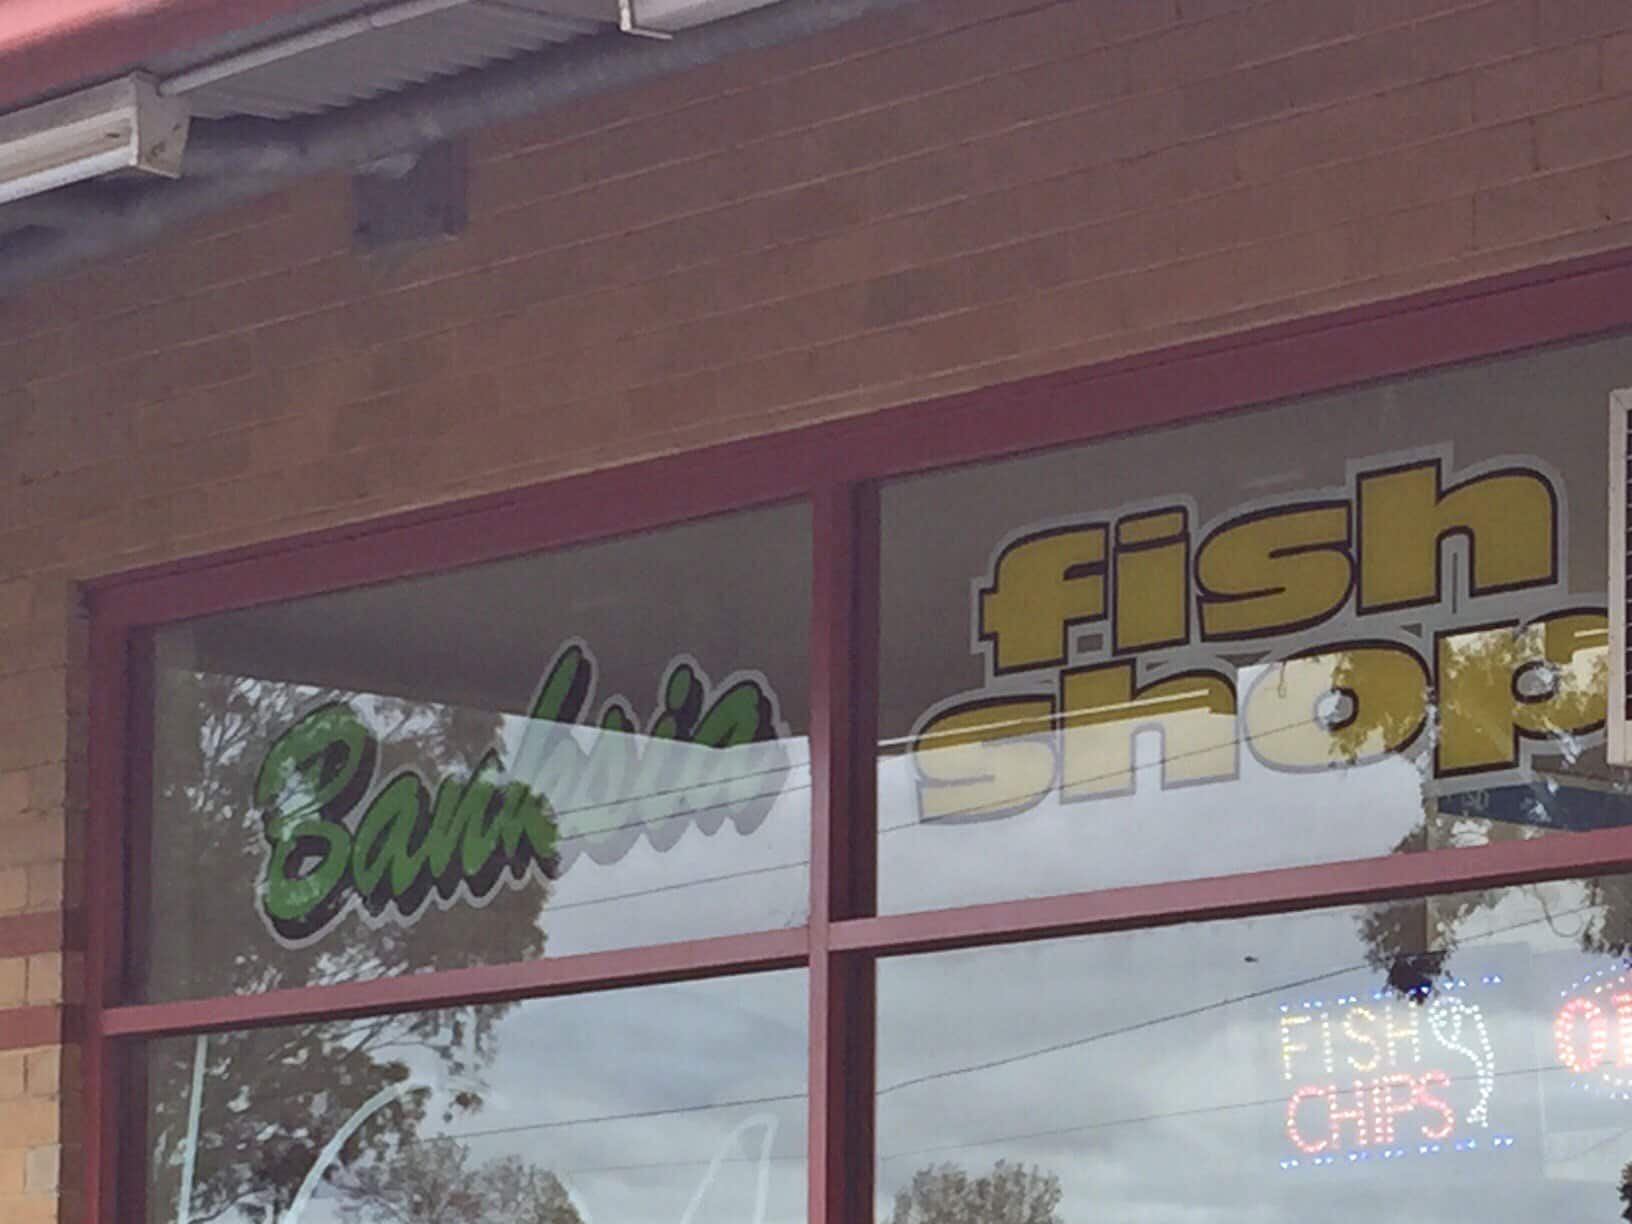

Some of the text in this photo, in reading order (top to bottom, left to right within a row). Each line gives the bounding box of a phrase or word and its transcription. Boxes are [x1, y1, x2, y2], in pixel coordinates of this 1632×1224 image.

[976, 457, 1560, 677] fish
[910, 606, 1608, 824] shop
[1280, 1000, 1421, 1080] FISH
[1286, 1070, 1454, 1153] CHIPS
